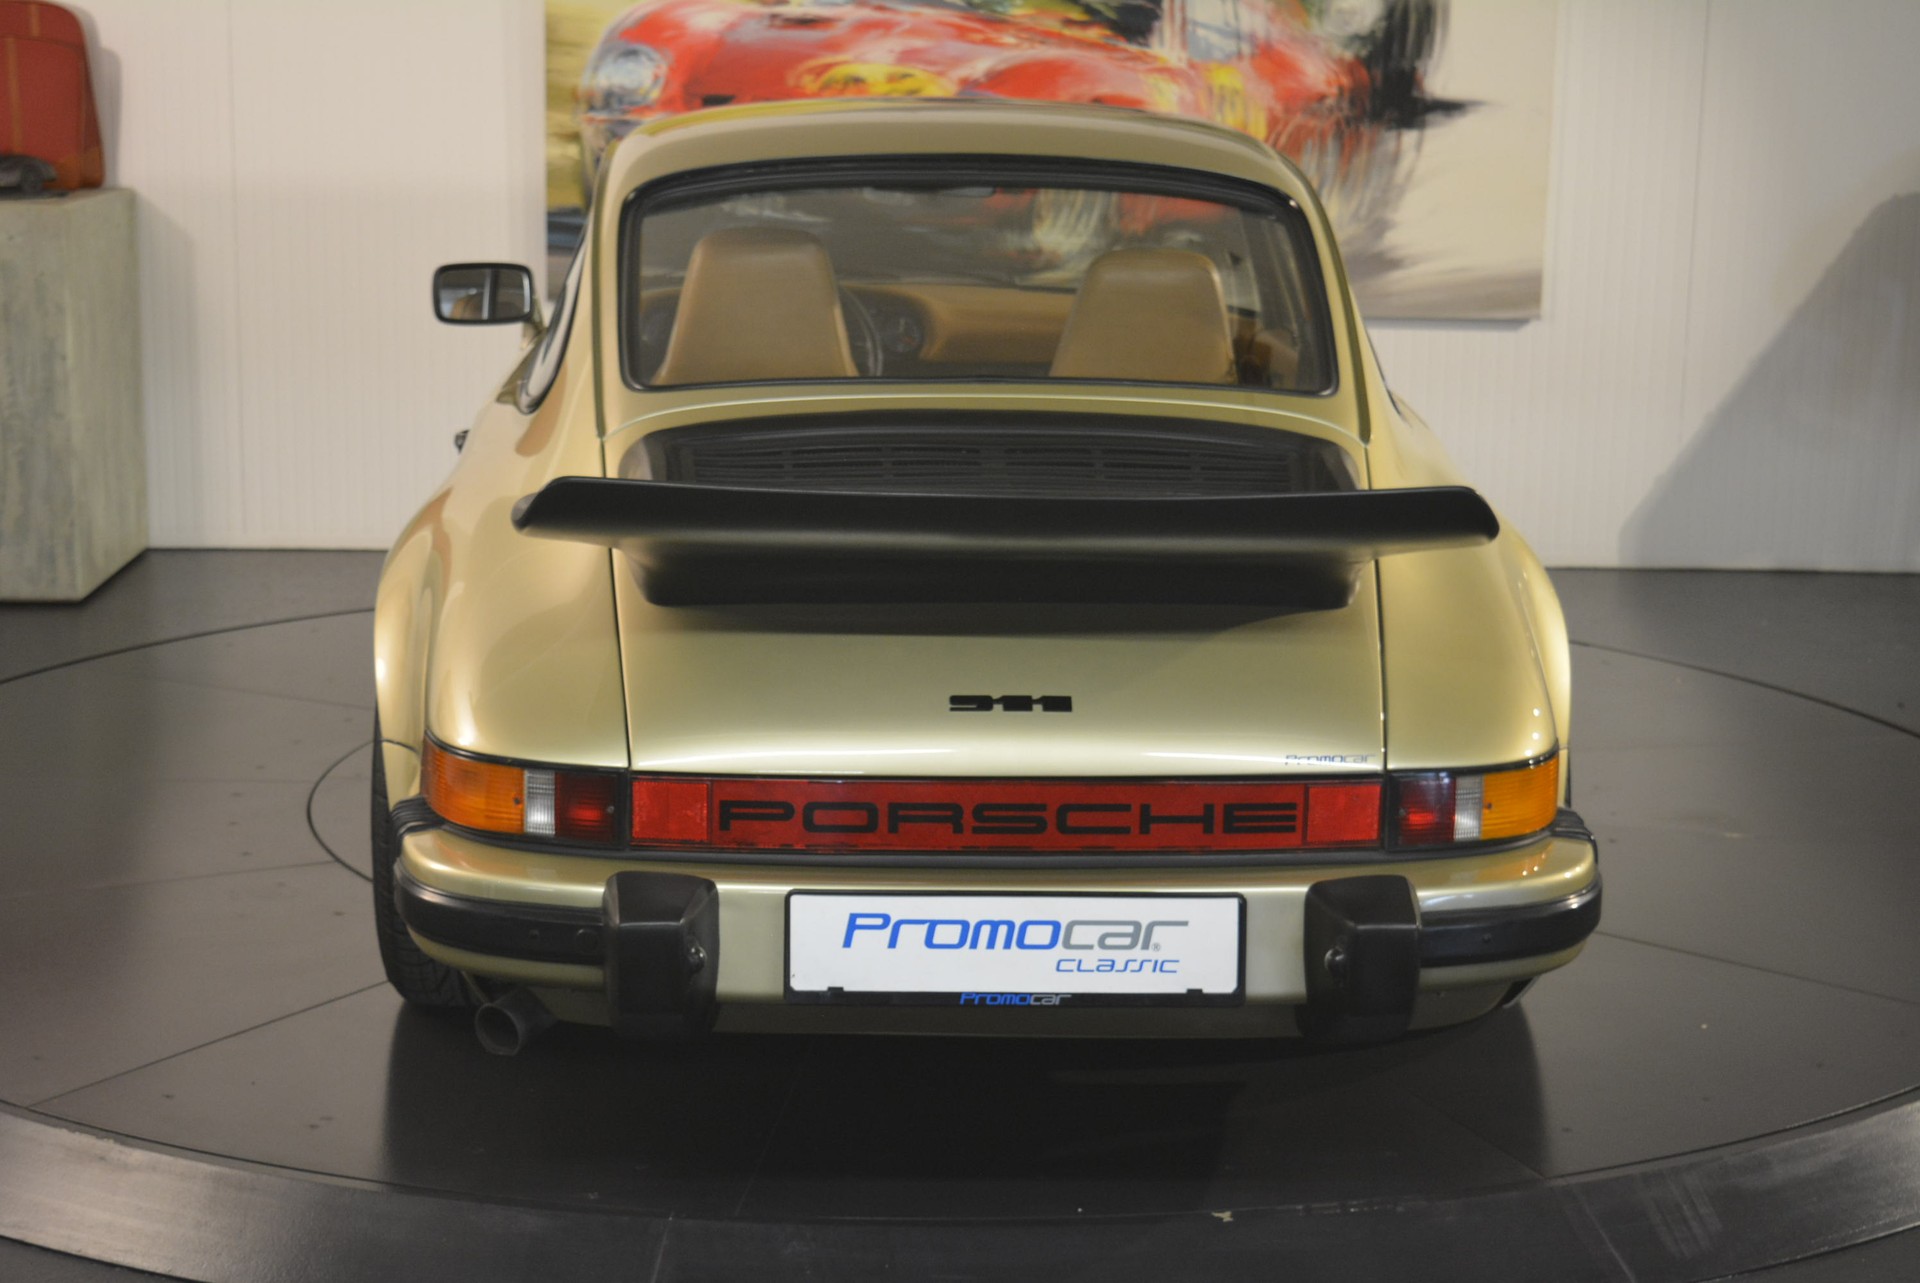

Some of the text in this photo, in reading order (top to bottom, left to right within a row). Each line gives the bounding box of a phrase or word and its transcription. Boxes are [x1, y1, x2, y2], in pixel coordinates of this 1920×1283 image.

[949, 695, 1072, 712] 911
[719, 800, 1297, 835] PORSCHE
[842, 913, 1189, 950] Promocar
[959, 992, 1072, 1005] Promocar
